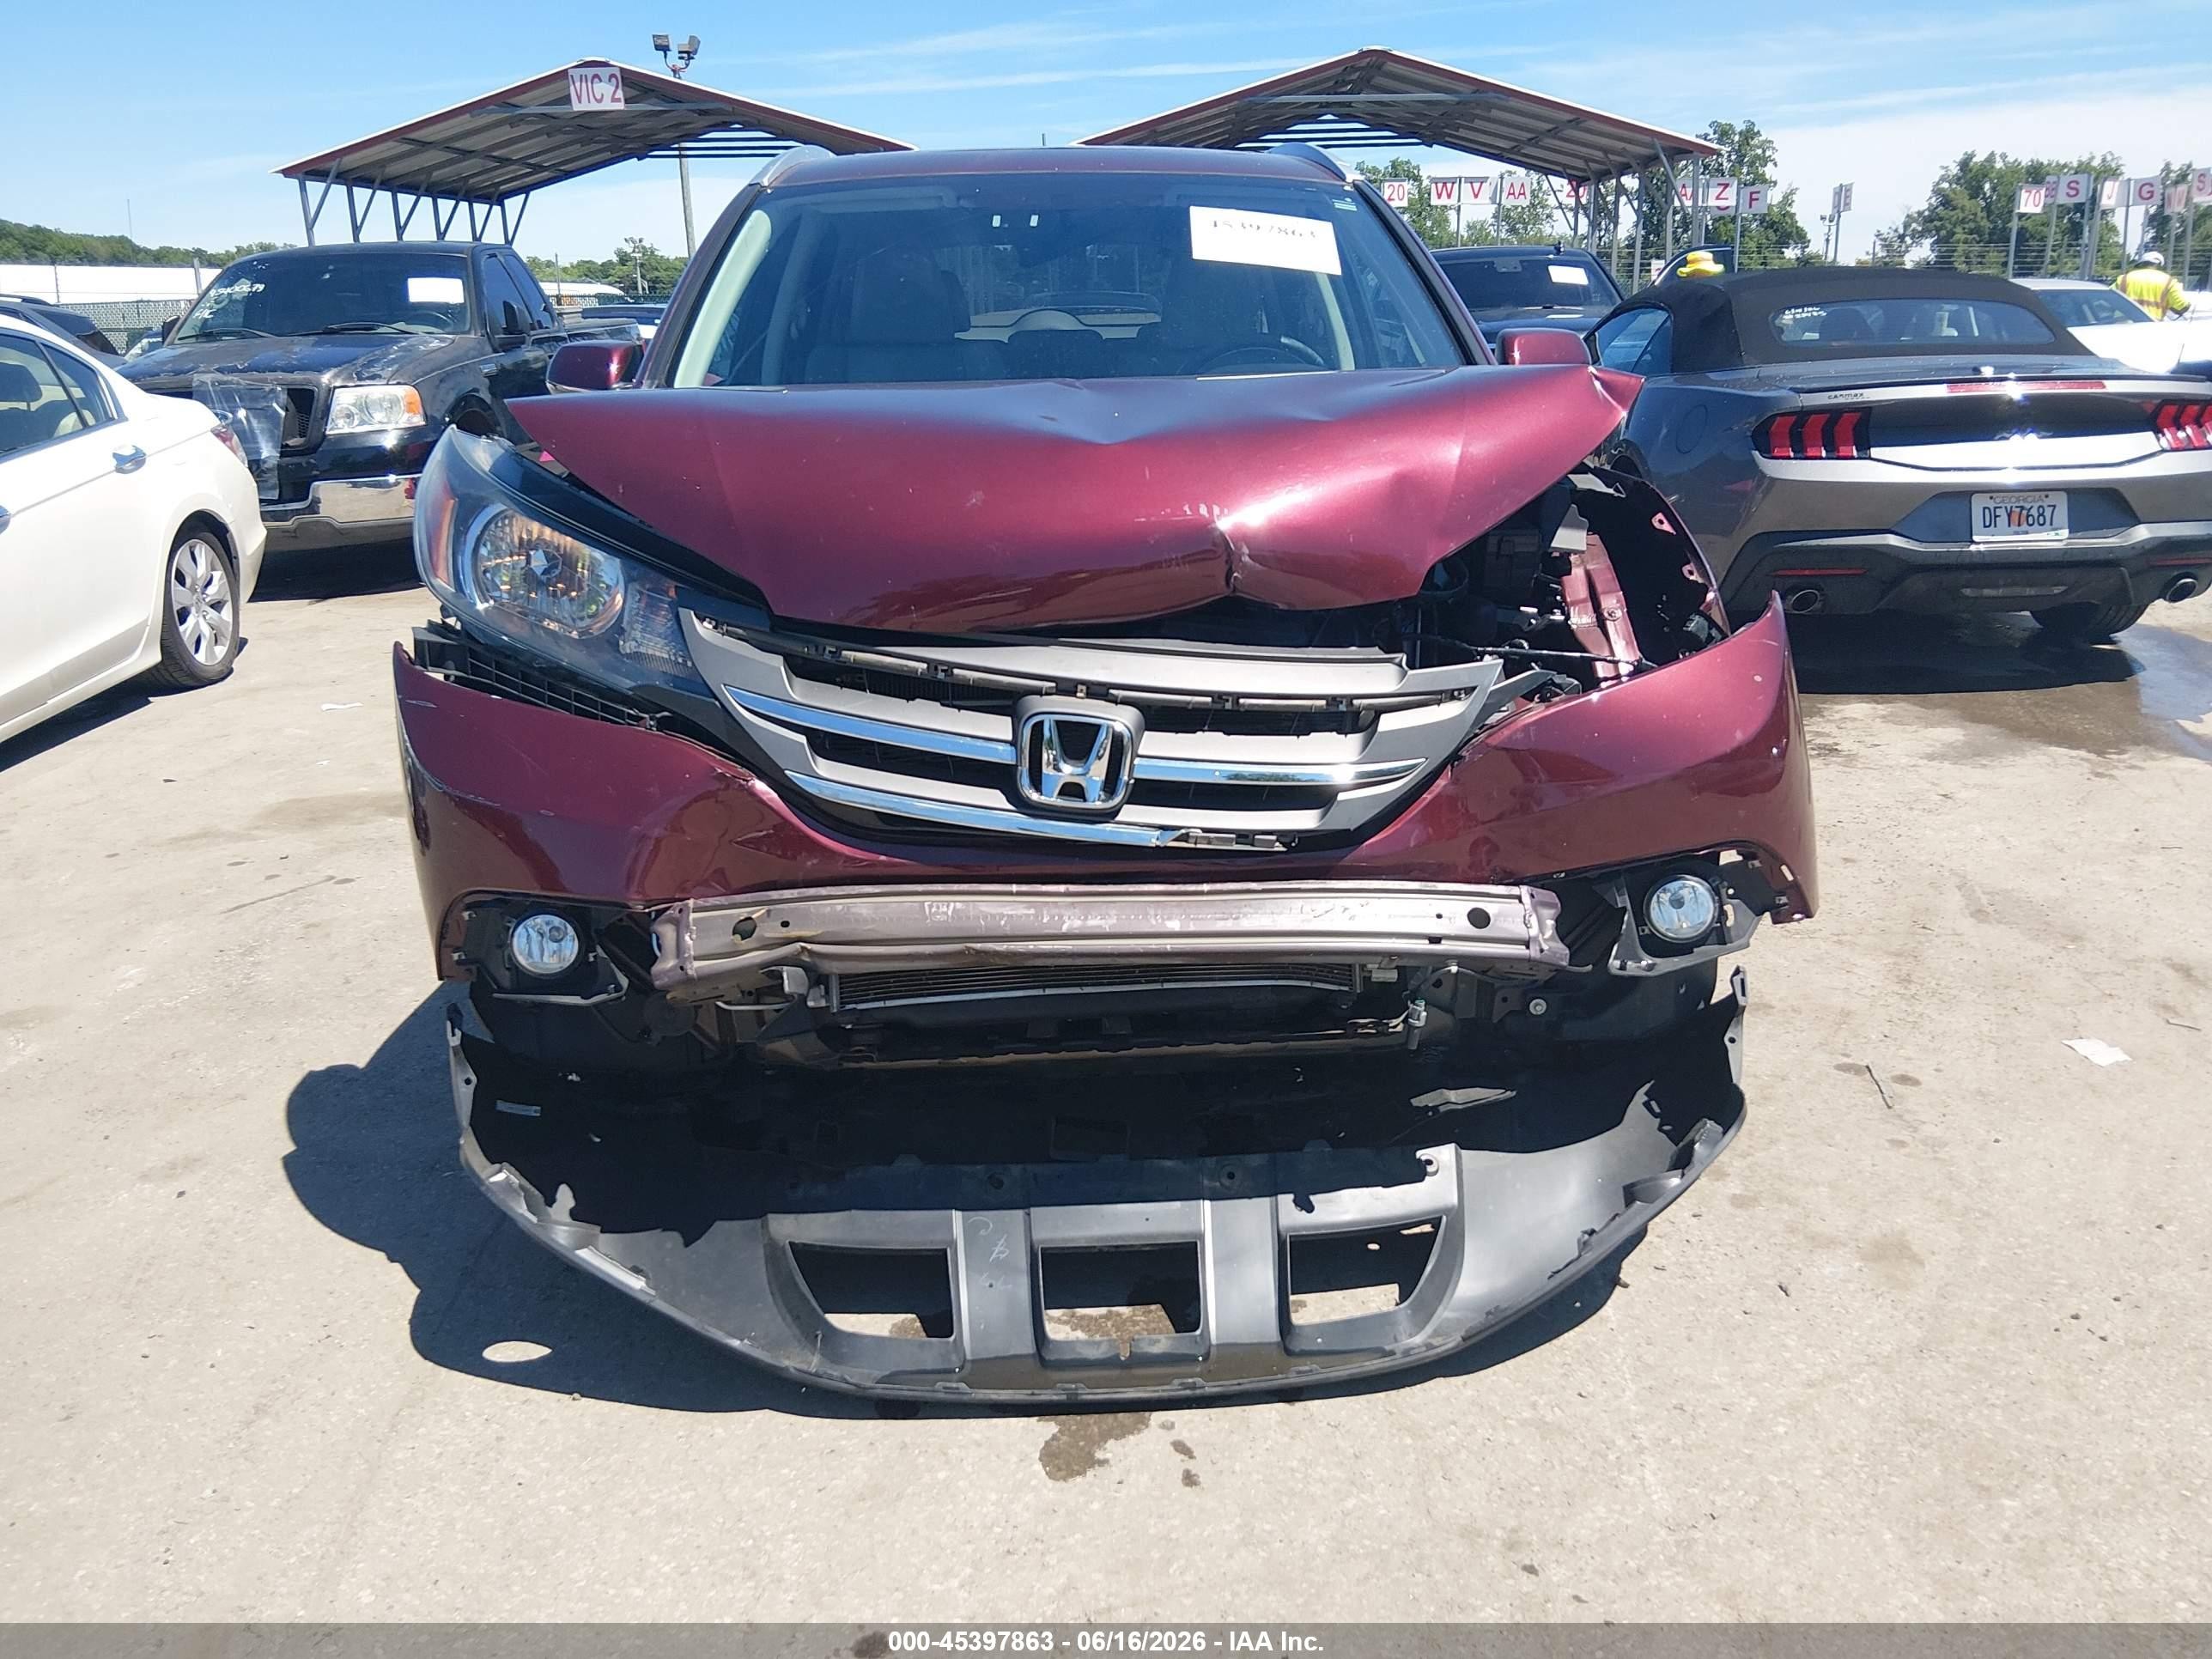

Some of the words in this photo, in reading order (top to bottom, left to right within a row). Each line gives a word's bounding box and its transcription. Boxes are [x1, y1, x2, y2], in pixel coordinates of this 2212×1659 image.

[570, 73, 604, 104] VIC
[608, 73, 623, 103] 2
[1435, 182, 1455, 200] W
[1470, 182, 1484, 199] V
[1506, 182, 1527, 200] AA
[2066, 179, 2080, 198] S
[2138, 182, 2154, 200] G
[2196, 173, 2206, 191] S
[1387, 184, 1405, 201] 20
[1715, 183, 1730, 201] Z
[1749, 191, 1761, 209] F
[2024, 190, 2041, 207] 70
[1994, 495, 2045, 505] GEORGIA
[1982, 505, 2057, 528] DFY7687
